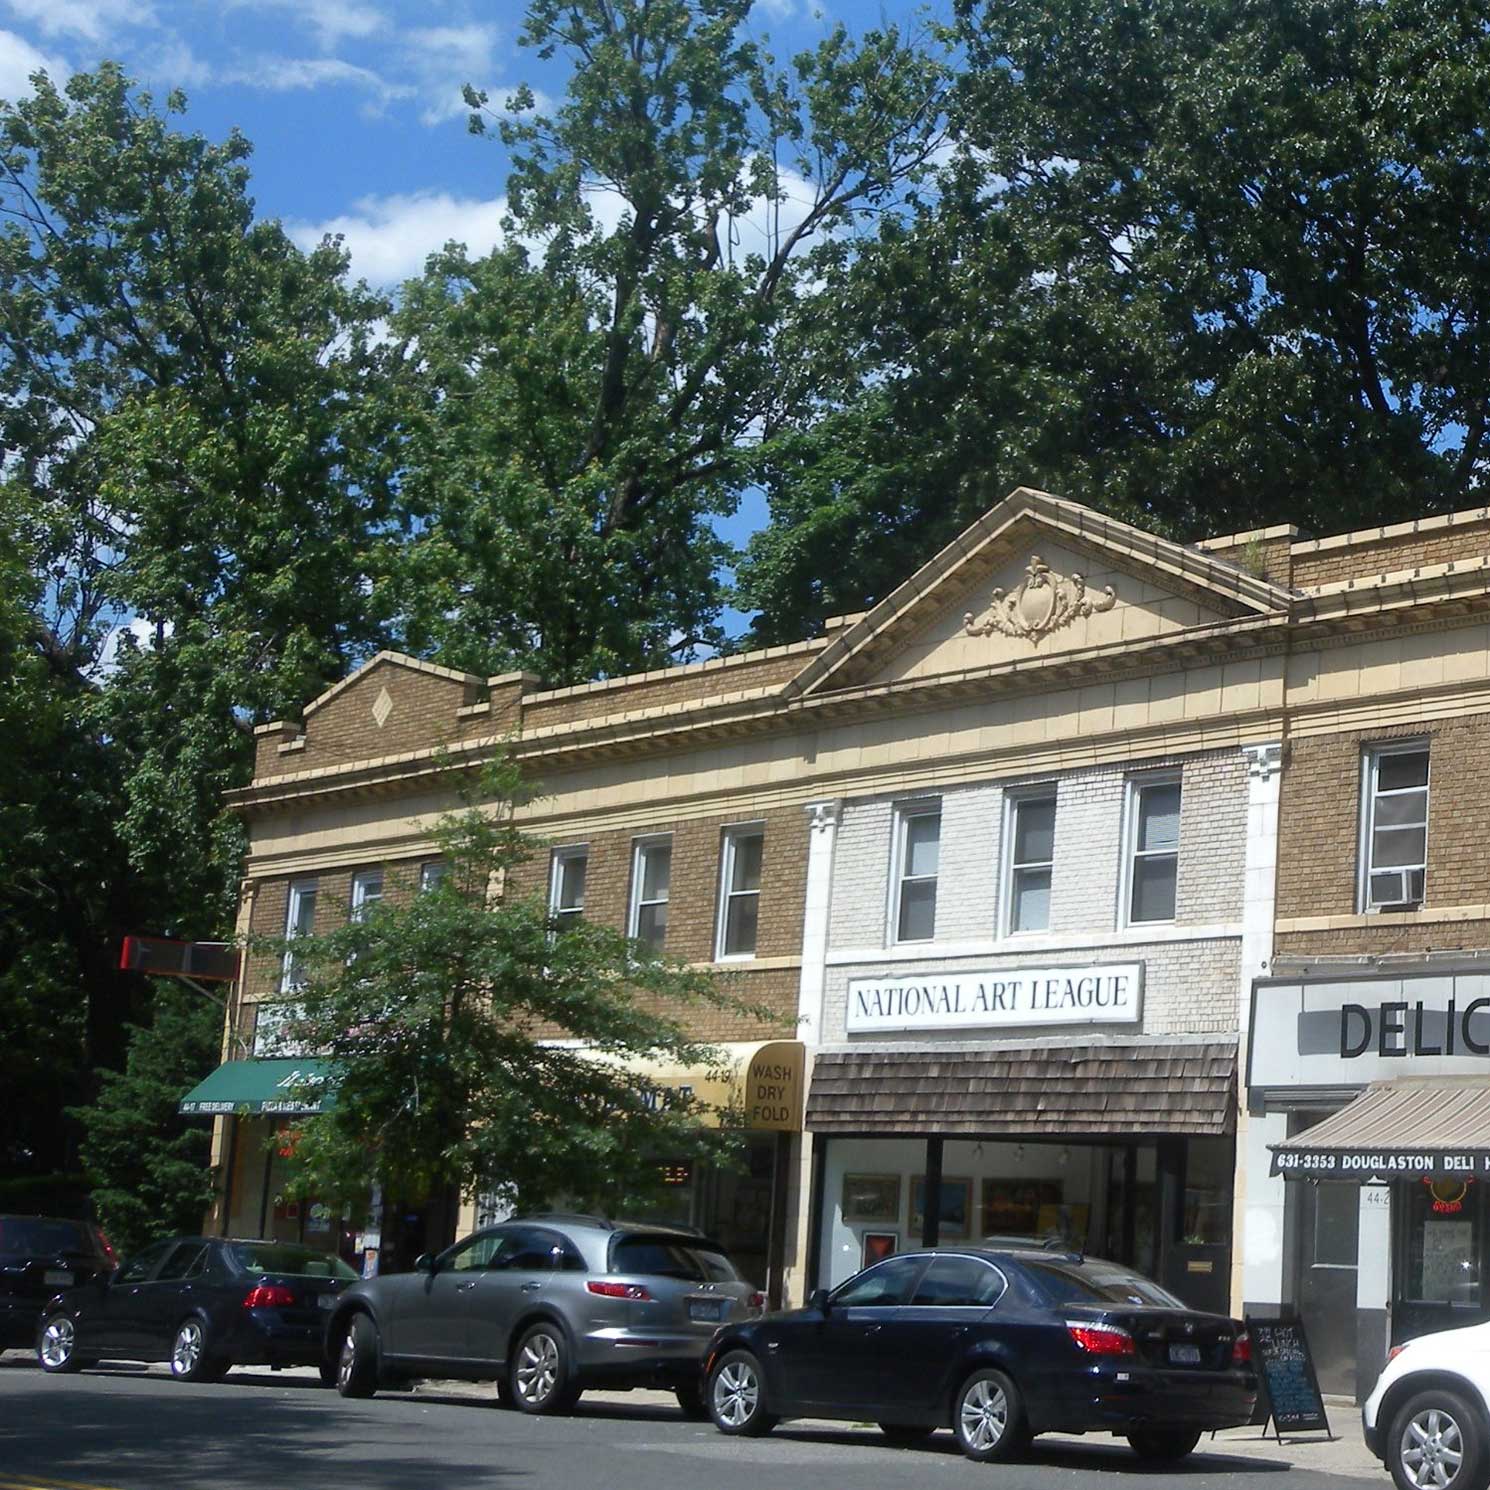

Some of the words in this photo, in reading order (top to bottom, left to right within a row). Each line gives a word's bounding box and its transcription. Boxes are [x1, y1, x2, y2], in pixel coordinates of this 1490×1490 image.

[855, 984, 966, 1018] NATIONAL
[971, 981, 1022, 1013] ART
[1031, 975, 1129, 1010] LEAGUE
[753, 1064, 792, 1081] WASH
[757, 1085, 785, 1101] DRY
[753, 1105, 789, 1122] FOLD
[1277, 1153, 1336, 1169] 631-3353
[1342, 1155, 1434, 1170] DOUGLASTON
[1443, 1155, 1474, 1171] DELI
